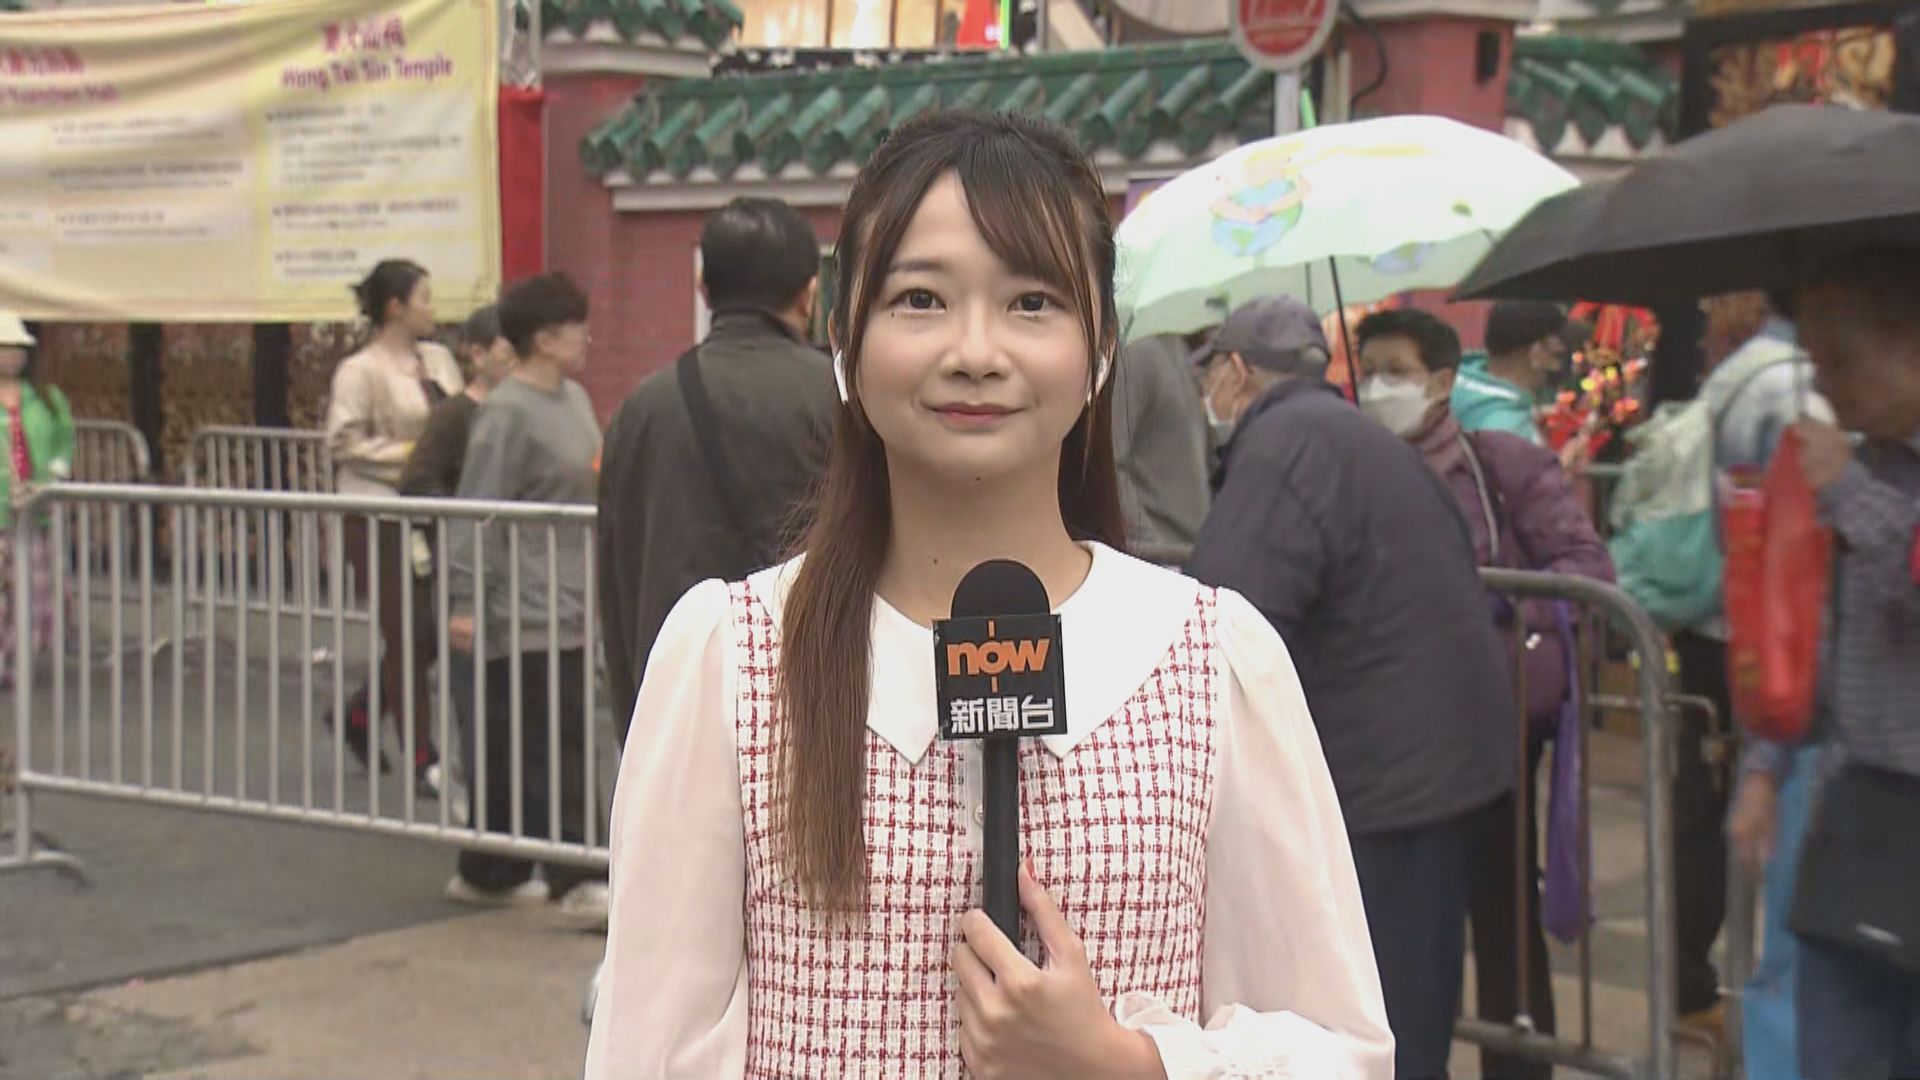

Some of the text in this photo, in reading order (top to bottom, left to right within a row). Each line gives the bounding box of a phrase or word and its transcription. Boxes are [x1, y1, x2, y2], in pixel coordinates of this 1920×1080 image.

[394, 53, 453, 81] Temple
[946, 638, 1050, 676] now
[950, 694, 1055, 734] 新聞台
